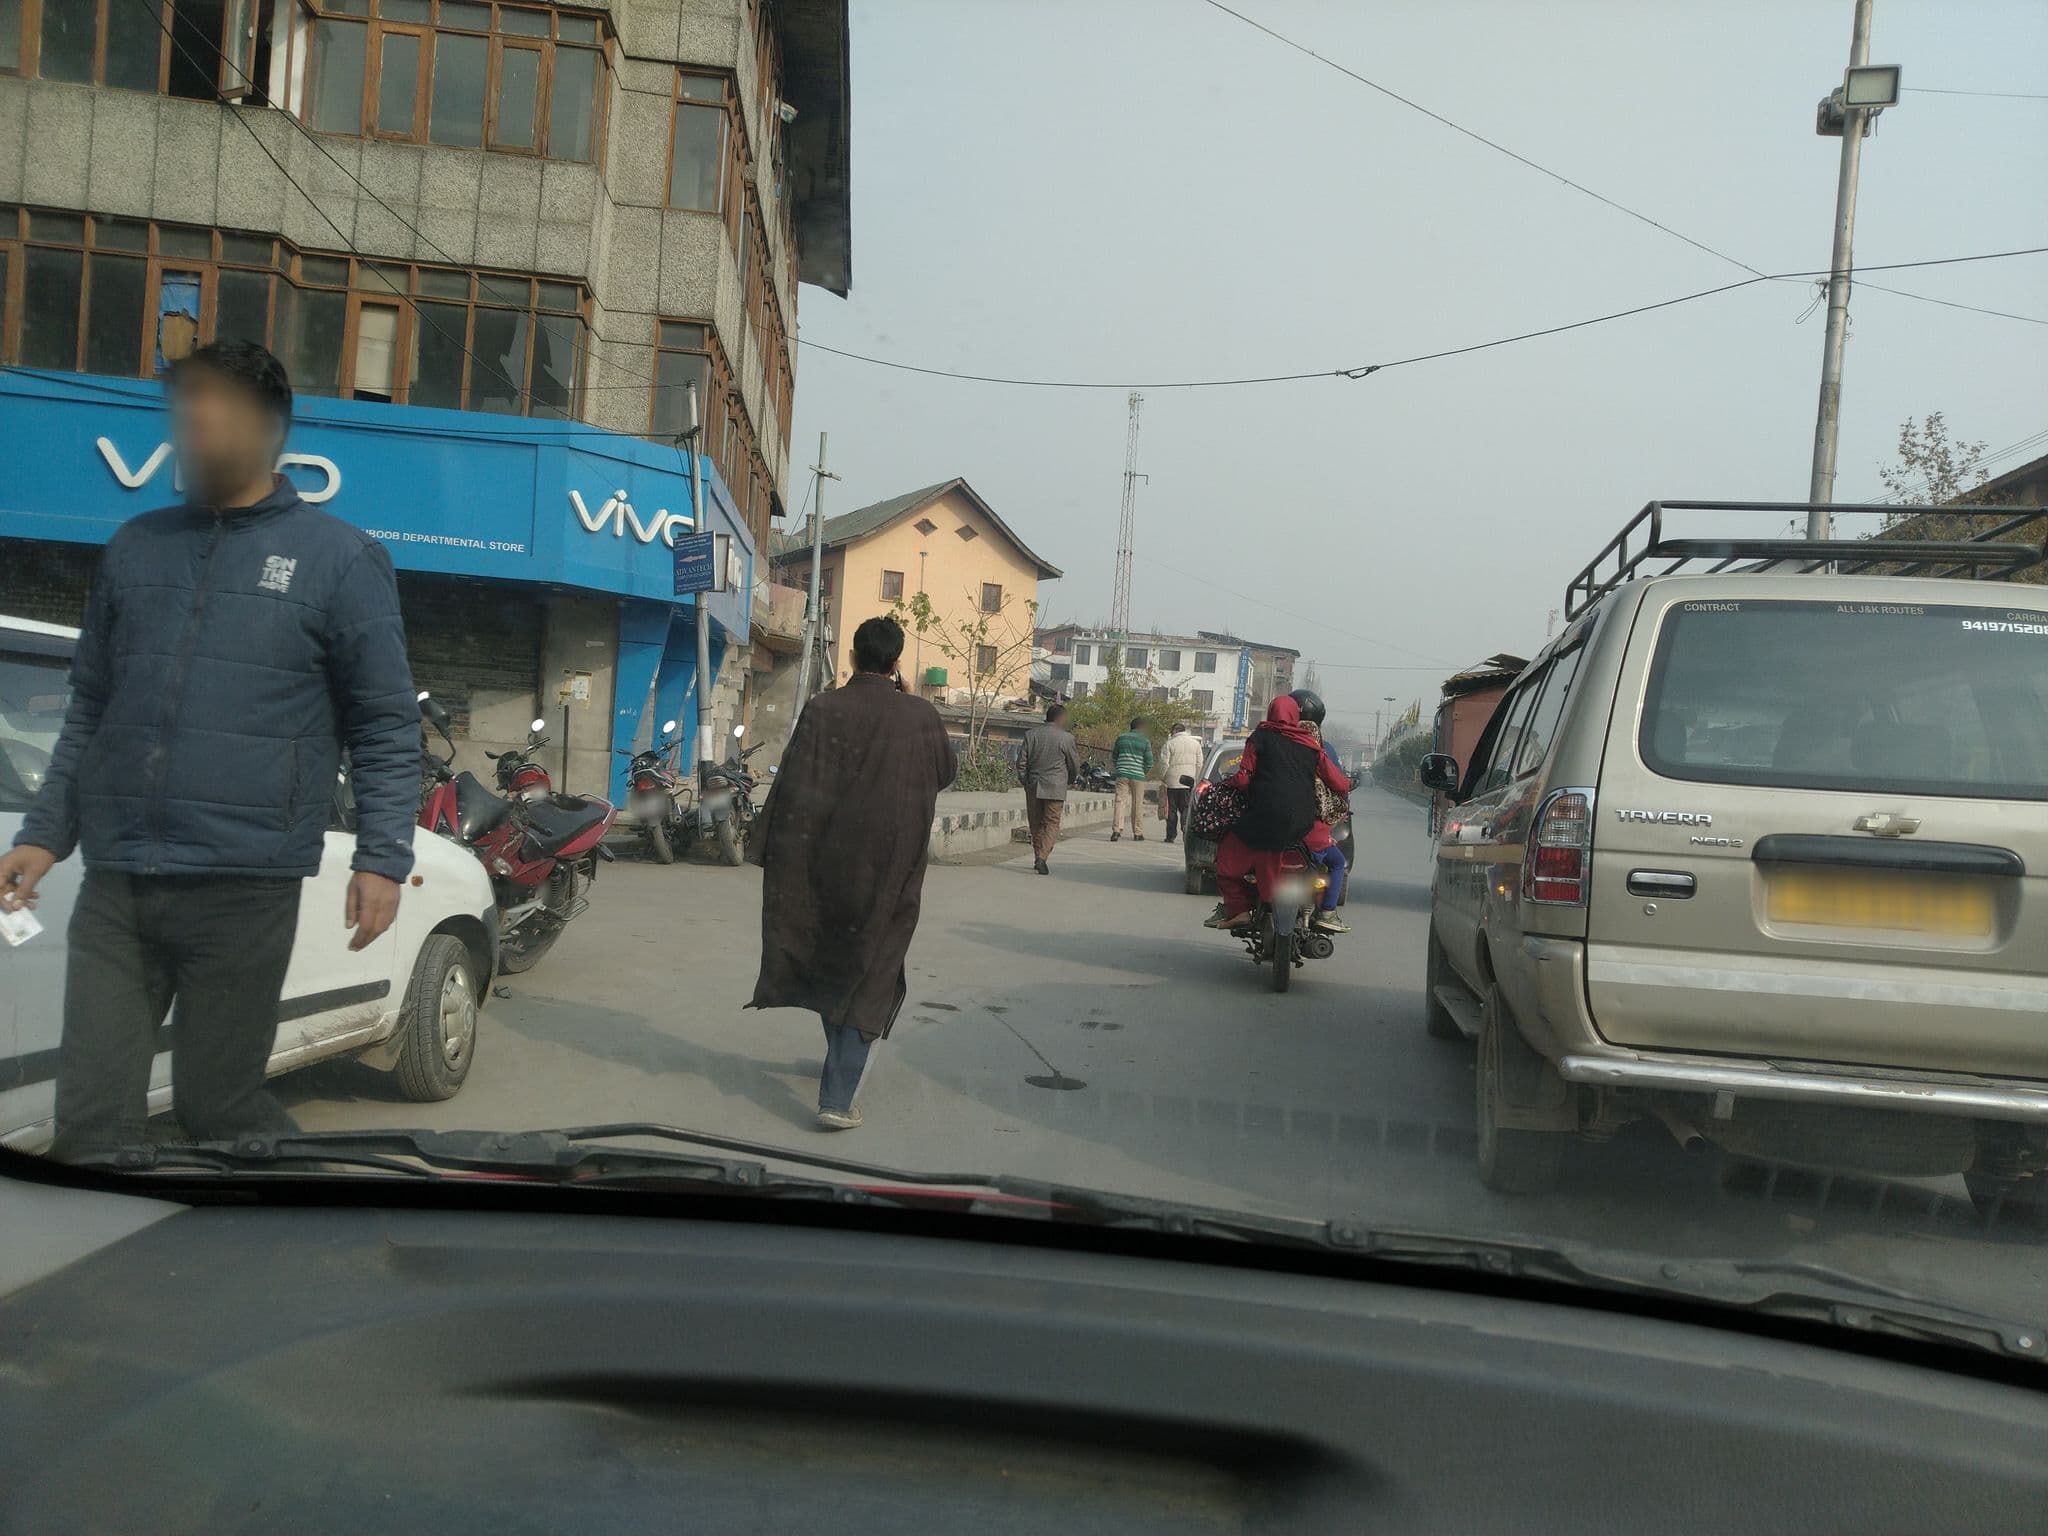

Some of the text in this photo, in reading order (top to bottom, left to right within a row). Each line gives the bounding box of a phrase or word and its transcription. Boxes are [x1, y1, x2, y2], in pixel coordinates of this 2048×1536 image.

[402, 532, 486, 549] DEPARTMENTAL
[489, 541, 525, 553] STORE
[262, 567, 293, 583] THE
[1684, 603, 1740, 612] CONTRACT
[1836, 604, 1924, 616] ALL J&K ROUTES
[1616, 809, 1712, 828] TAVERA
